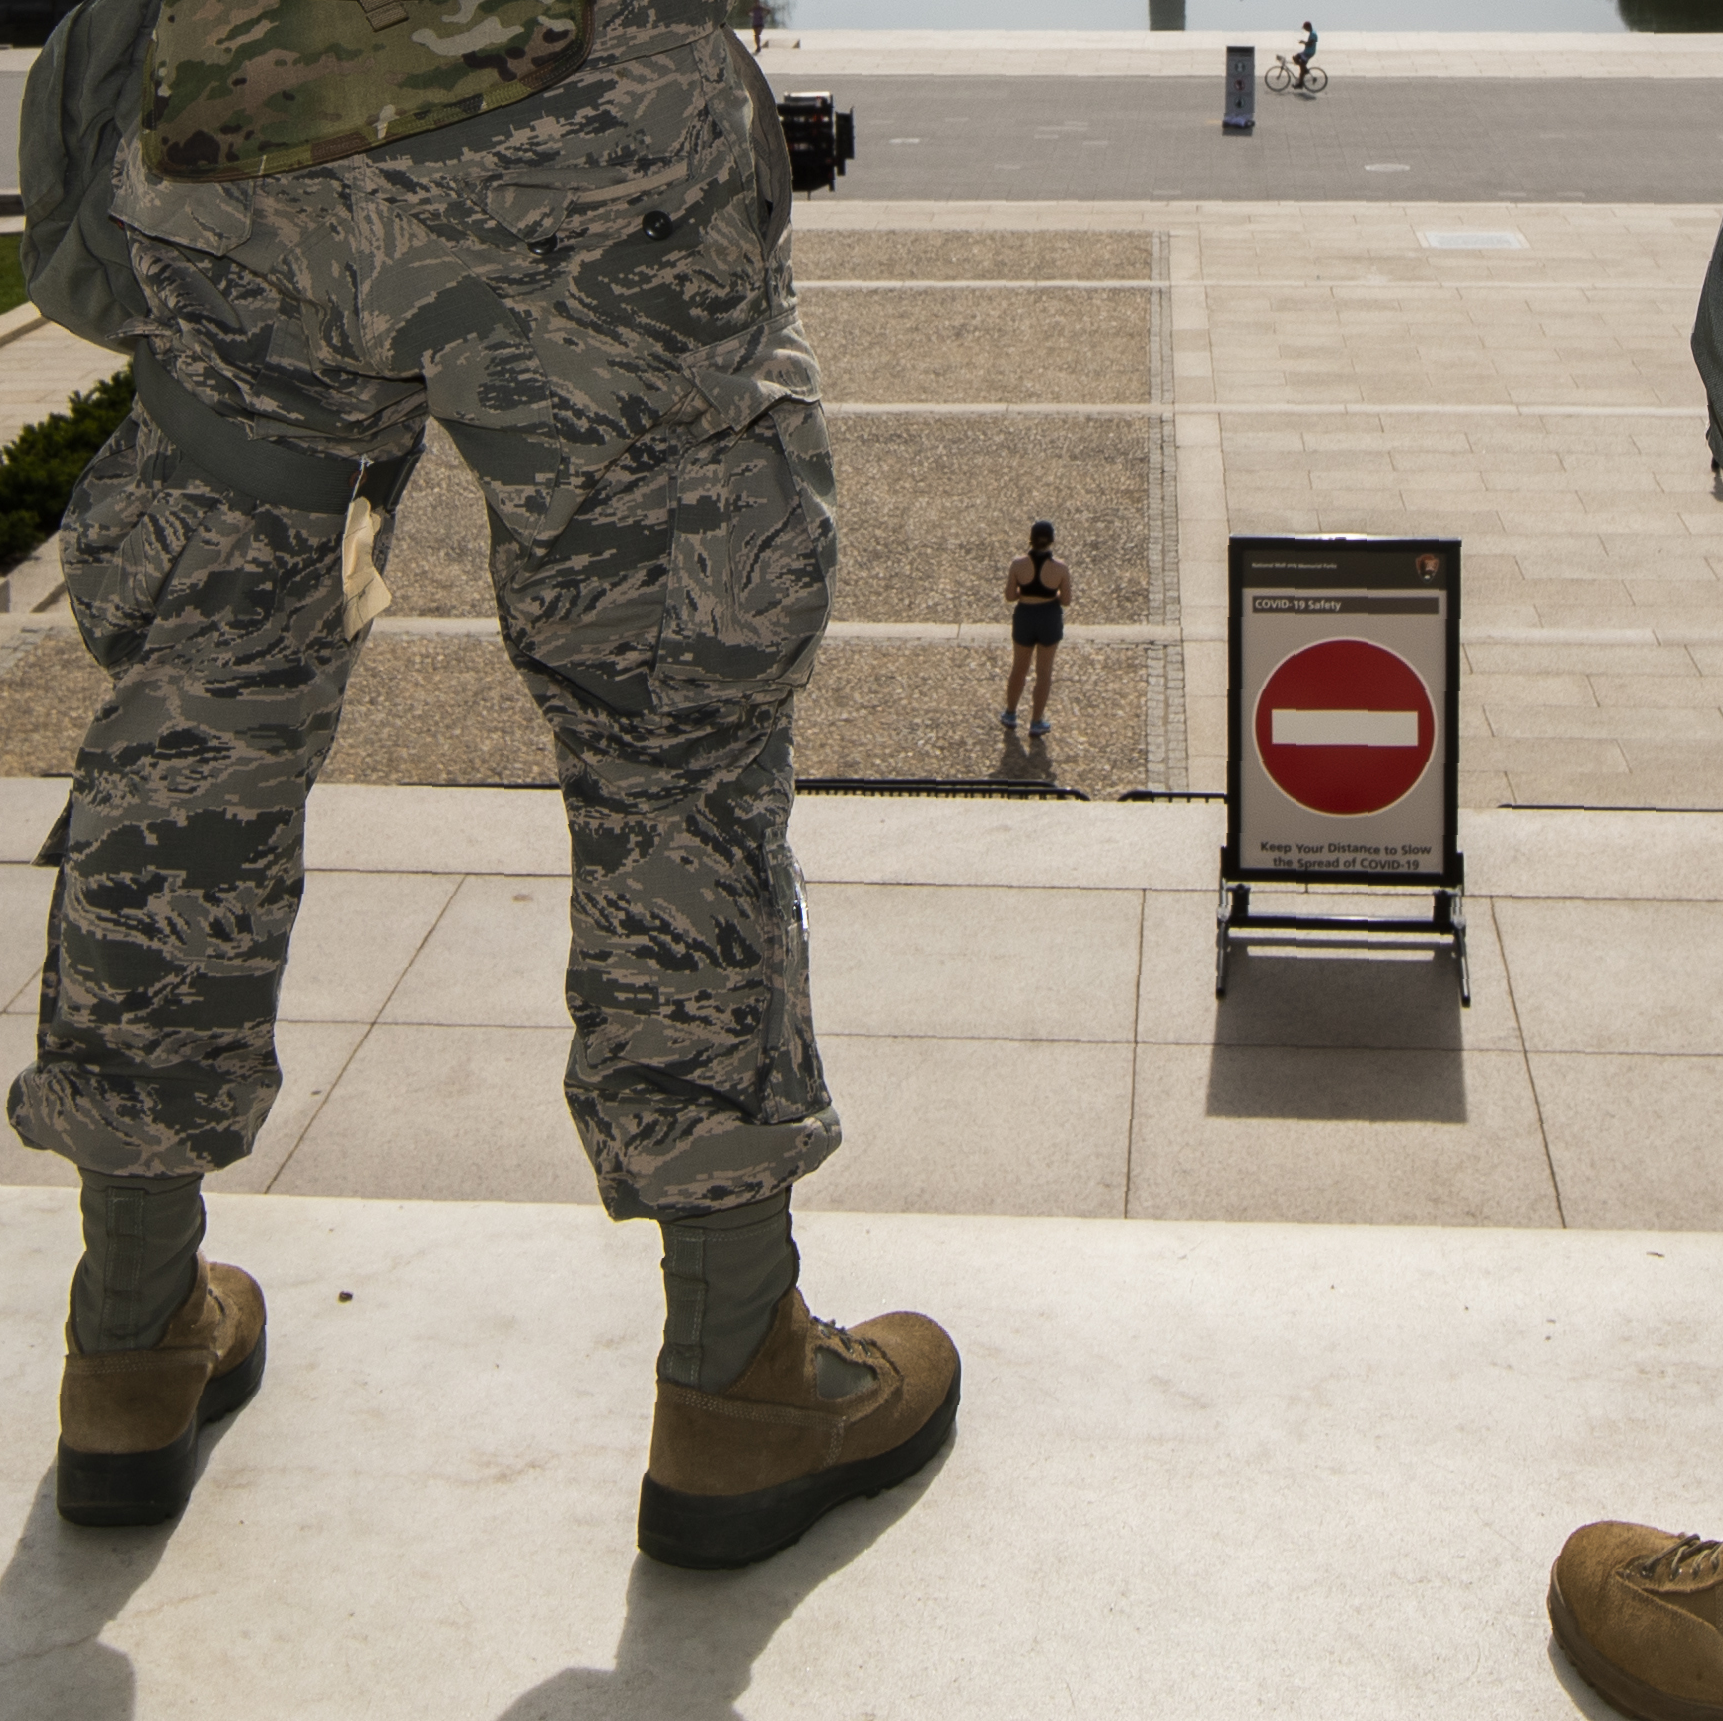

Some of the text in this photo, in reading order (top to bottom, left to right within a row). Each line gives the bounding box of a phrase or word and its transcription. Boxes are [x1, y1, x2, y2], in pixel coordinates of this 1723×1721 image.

[1255, 599, 1342, 612] COVID-19 Safety
[1260, 841, 1432, 855] Keep Your Distance to Slow
[1273, 857, 1420, 870] the Spread of COVID-19
